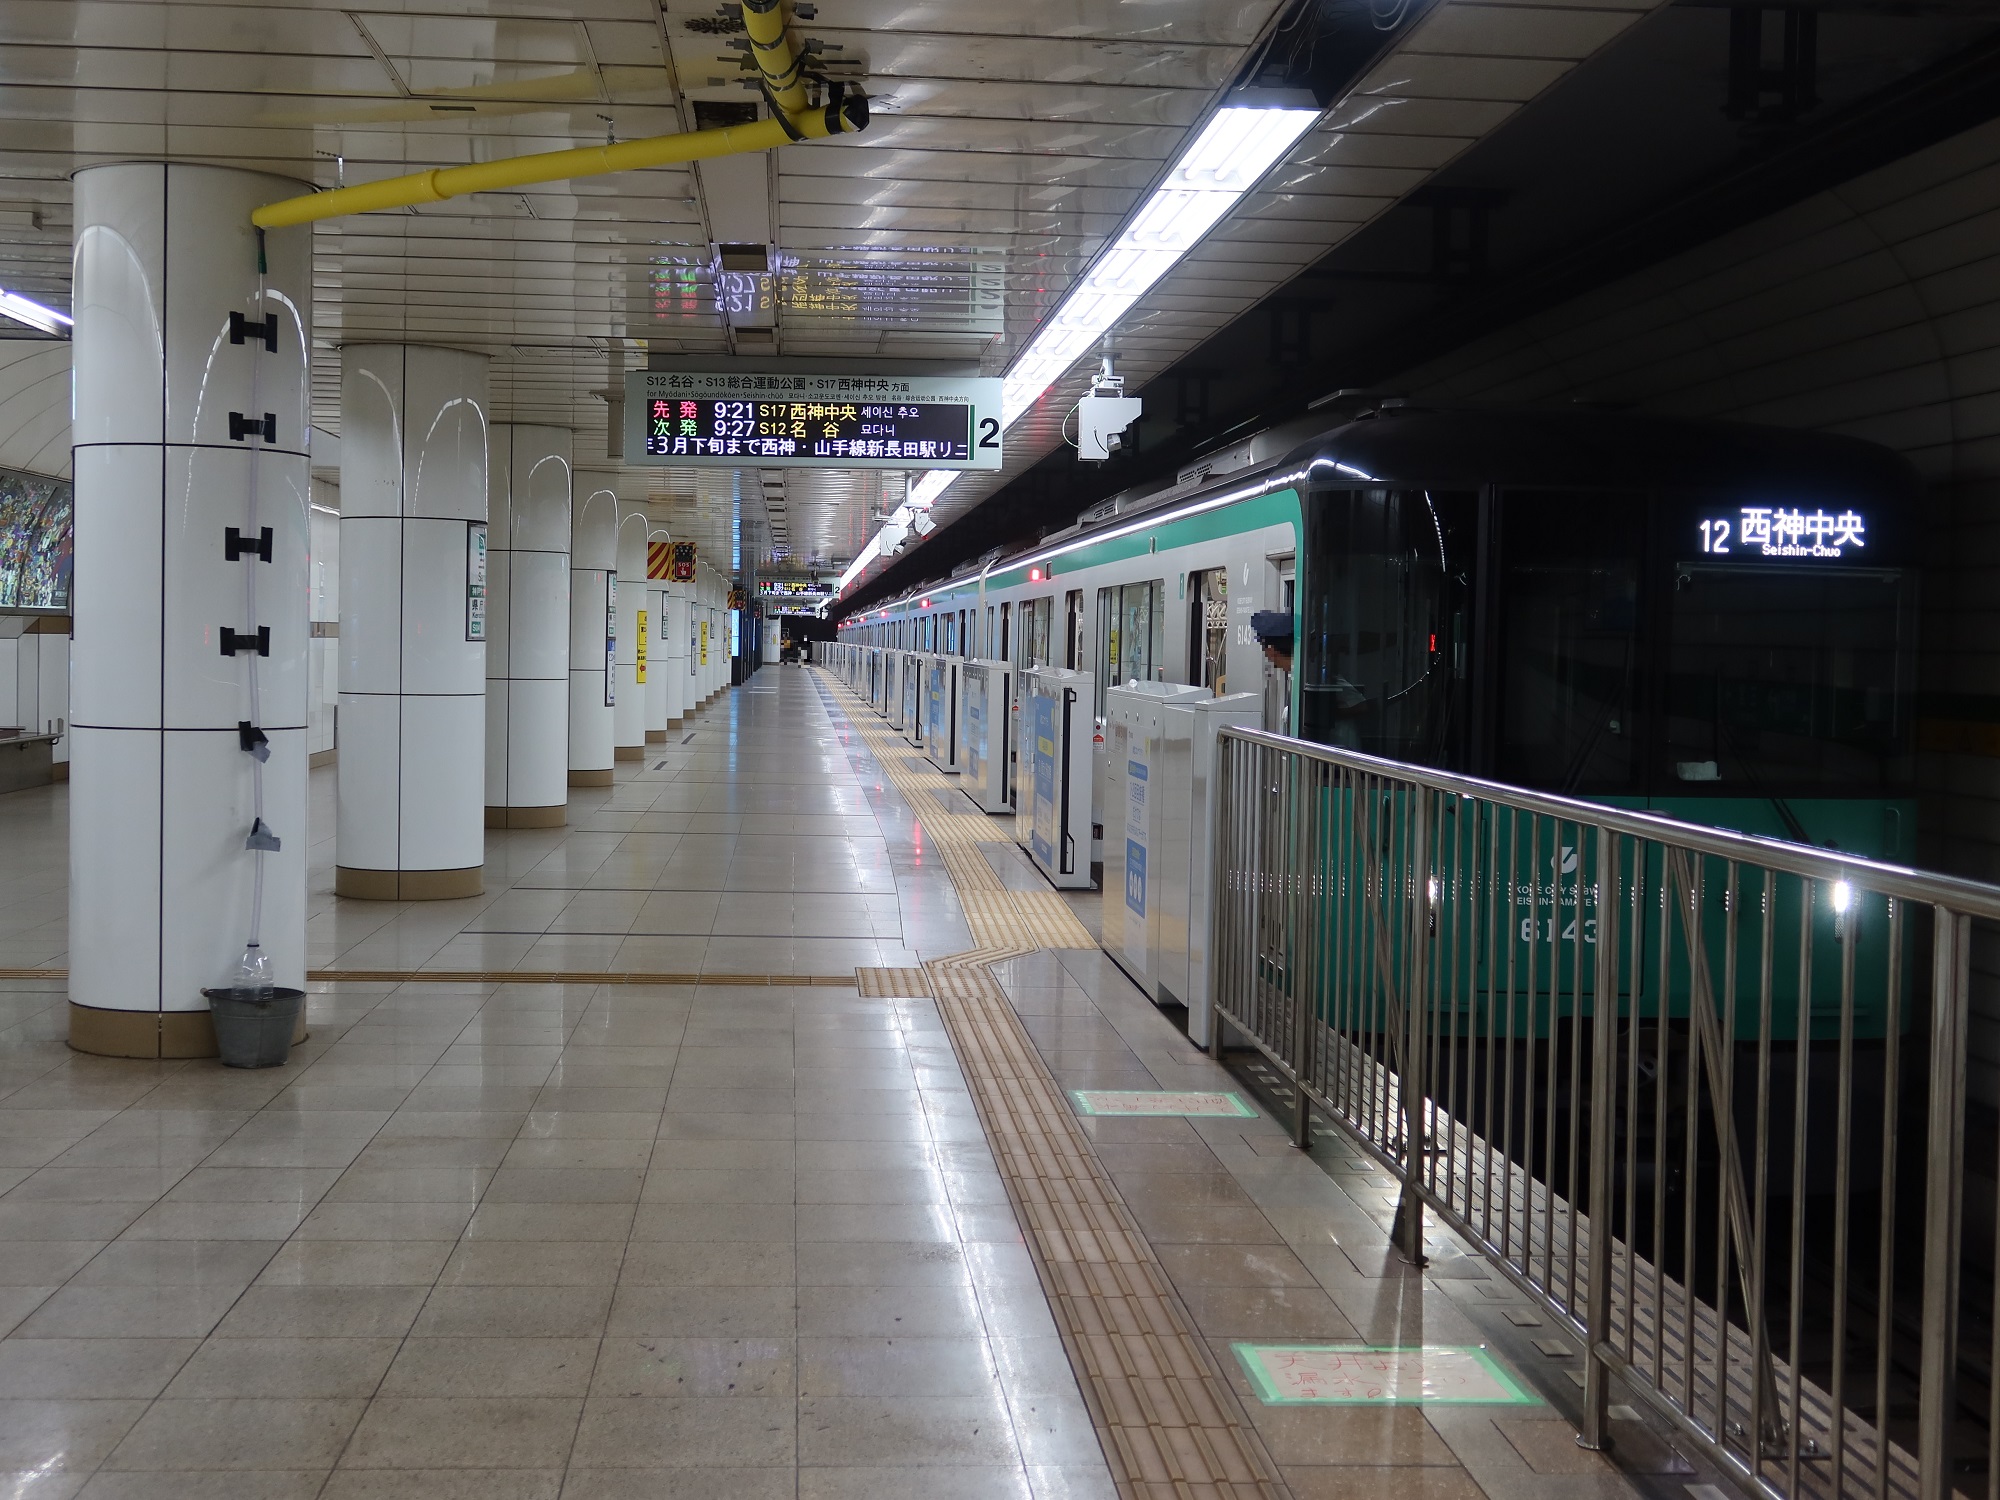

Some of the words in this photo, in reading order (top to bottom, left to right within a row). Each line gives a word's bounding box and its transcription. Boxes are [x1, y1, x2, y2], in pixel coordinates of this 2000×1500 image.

[647, 390, 658, 398] for
[714, 402, 753, 419] 9:21
[759, 404, 787, 417] S17
[790, 403, 857, 421] 西神中央
[860, 405, 894, 419] 세이신
[897, 406, 920, 419] 추오
[714, 419, 756, 437] 9:27
[759, 422, 787, 435] S12
[860, 424, 895, 437] 묘다니
[978, 417, 1000, 448] 2
[1700, 519, 1731, 554] 12
[1740, 507, 1866, 547] 西神中央
[1761, 543, 1841, 557] Seishin-Chuo
[834, 586, 840, 594] 2
[1237, 624, 1252, 646] 6143
